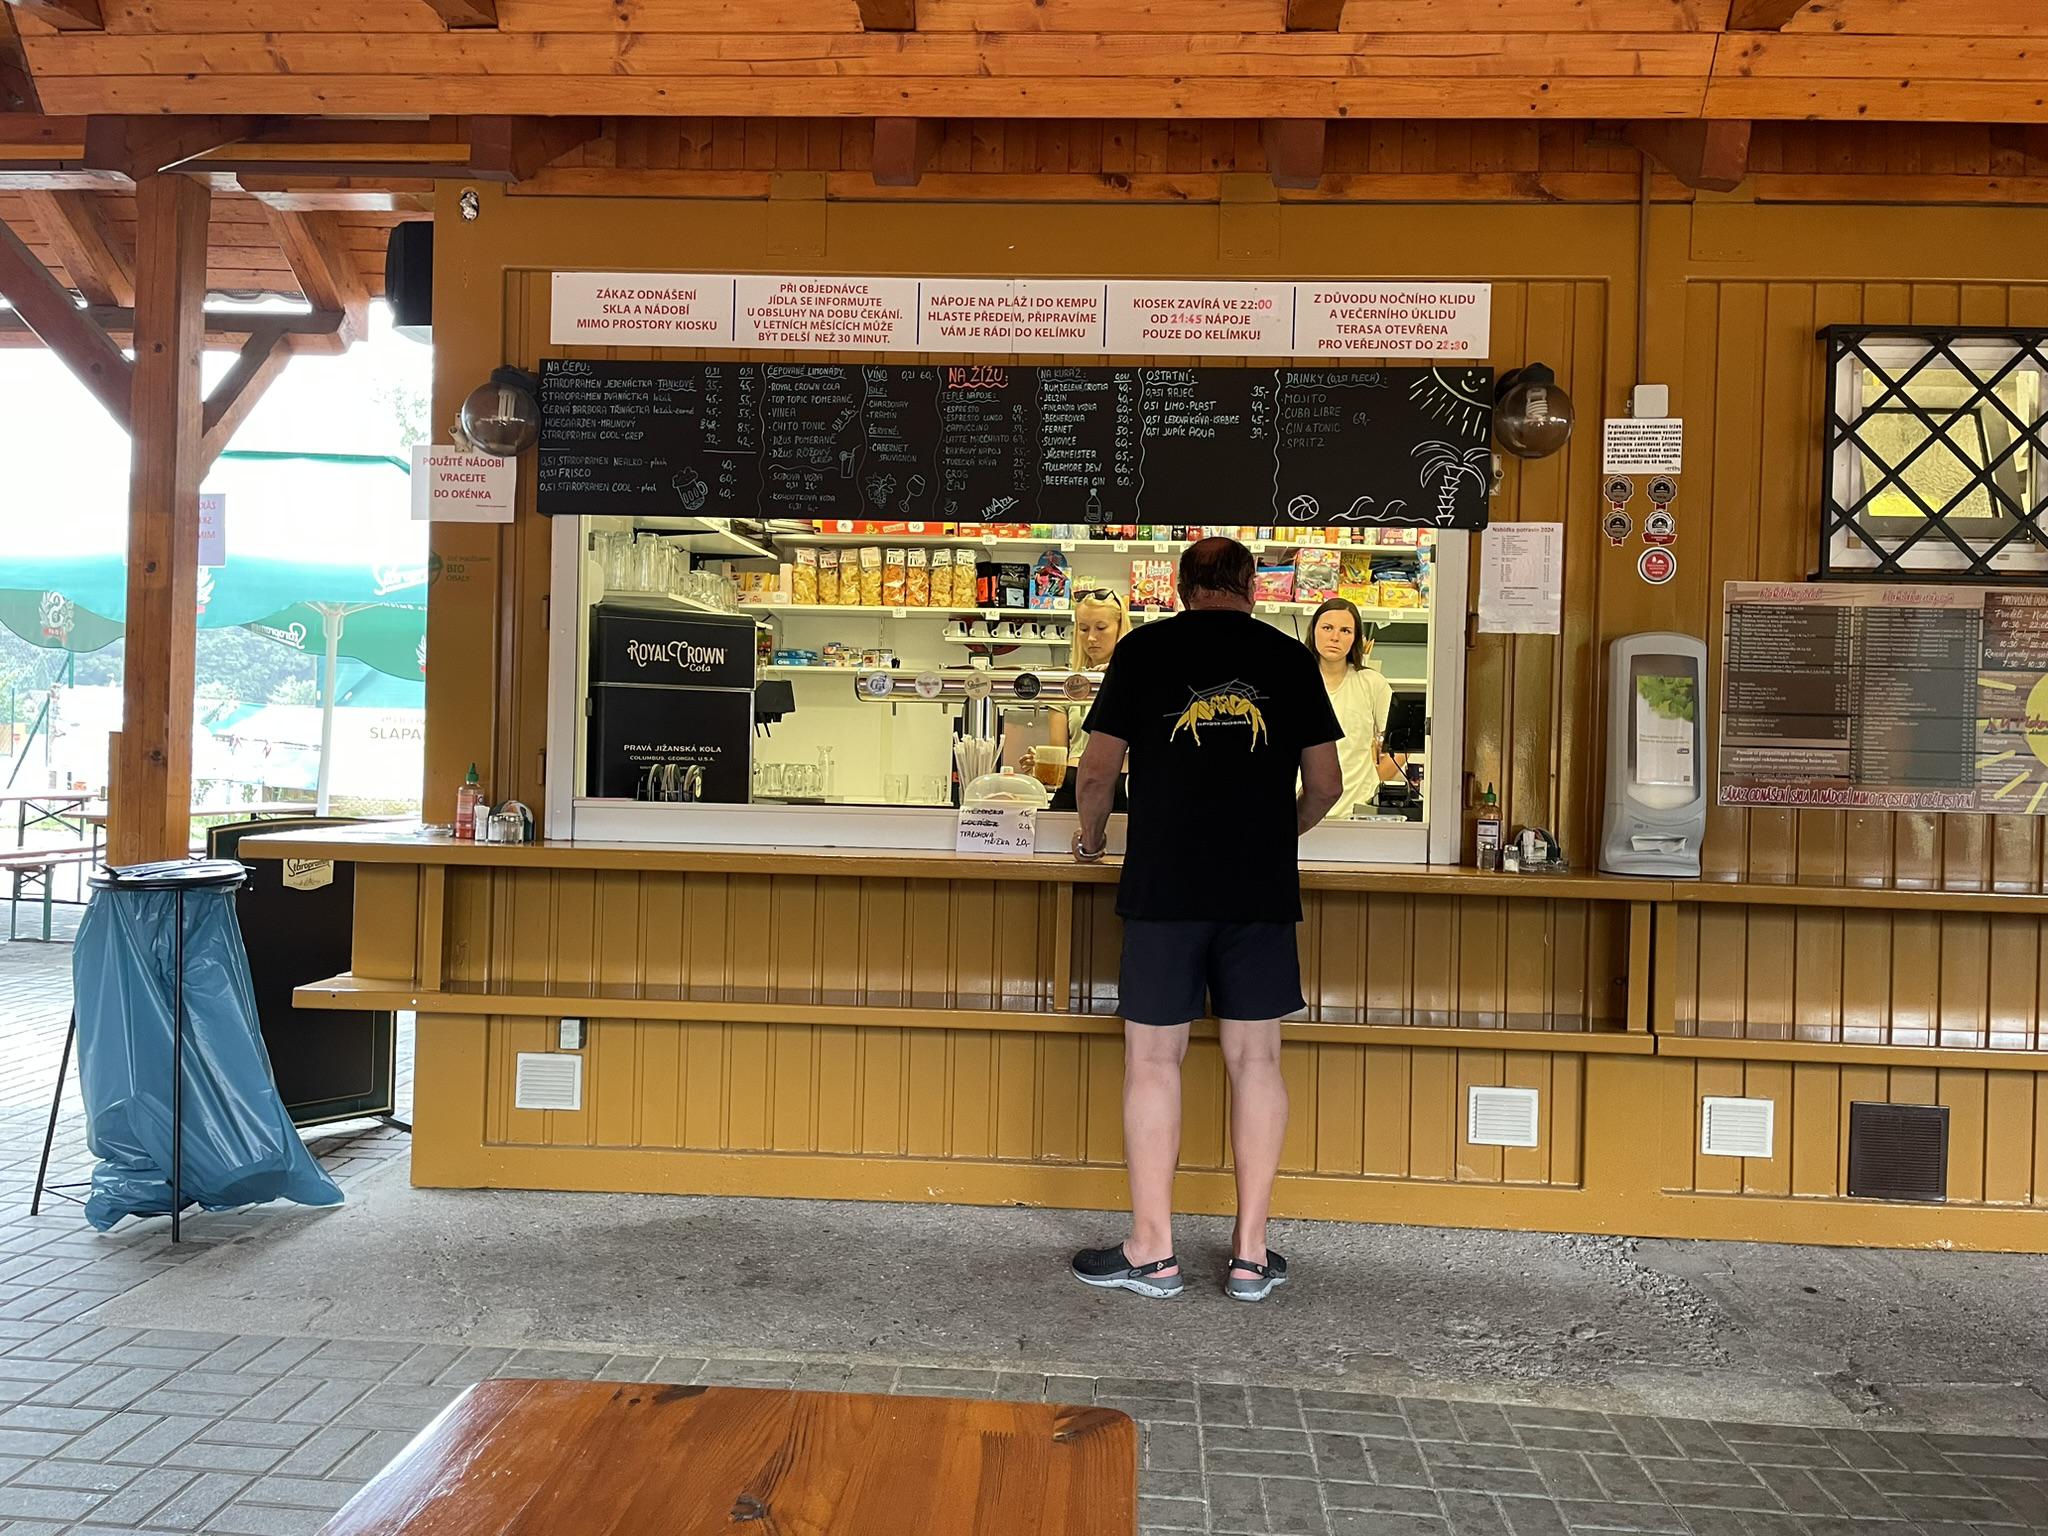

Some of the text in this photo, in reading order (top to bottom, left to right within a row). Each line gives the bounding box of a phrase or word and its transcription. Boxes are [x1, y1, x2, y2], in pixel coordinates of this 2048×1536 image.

[596, 288, 697, 300] ZÁKAZ ODNÁŠENÍ
[780, 283, 869, 294] PŘI OBJEDNÁVCE
[768, 295, 882, 307] JÍDLA SE INFORMUJTE
[931, 295, 976, 307] NÁPOJE
[978, 297, 994, 307] NA
[997, 296, 1027, 307] PLÁŽ
[1036, 298, 1054, 308] DO
[1056, 298, 1097, 308] KEMPU
[1133, 297, 1273, 310] KIOSEK ZAVÍRÁ VE 22:00
[1314, 292, 1476, 305] Z DŮVODU NOČNÍHO KLIDU
[602, 303, 690, 315] SKLA A NÁDOBÍ
[747, 307, 903, 319] U OBSLUHY NA DOBU ČEKÁNÍ.
[1329, 308, 1456, 320] A VEČERNÍHO ÚKLIDU
[928, 311, 1097, 323] HLASTE PŘEDEM, PŘIPRAVÍME
[1150, 313, 1251, 325] OD 21:45 NÁPOJE
[577, 319, 718, 331] MIMO PROSTORY KIOSKU
[753, 319, 893, 331] V LETNÍCH MĚSÍCÍCH MŮŽE
[1336, 323, 1448, 335] TERASA OTEVŘENA
[758, 331, 890, 344] BÝT DELŠÍ NEŽ 30 MINUT.
[941, 325, 1086, 338] VÁM JE RÁDI DO KELÍMKU
[1142, 328, 1261, 340] POUZE DO KELÍMKU!
[1318, 339, 1343, 349] PRO
[1345, 338, 1412, 350] VEŘEJNOST
[1415, 340, 1433, 350] DO
[547, 361, 560, 373] NA
[867, 367, 888, 379] VÍNO
[948, 367, 966, 383] NA
[1286, 372, 1324, 384] DRINKY
[1044, 424, 1074, 434] FERNET
[422, 456, 505, 468] POUŽITÉ NÁDOBÍ
[440, 473, 486, 483] VRACEJTE
[558, 468, 592, 479] FRISCO
[434, 488, 492, 499] DO OKÉNKA
[627, 639, 725, 668] ROYAL CROWN
[689, 663, 712, 672] Cola
[623, 743, 652, 752] PRAVÁ
[654, 743, 697, 752] JIŽANSKÁ
